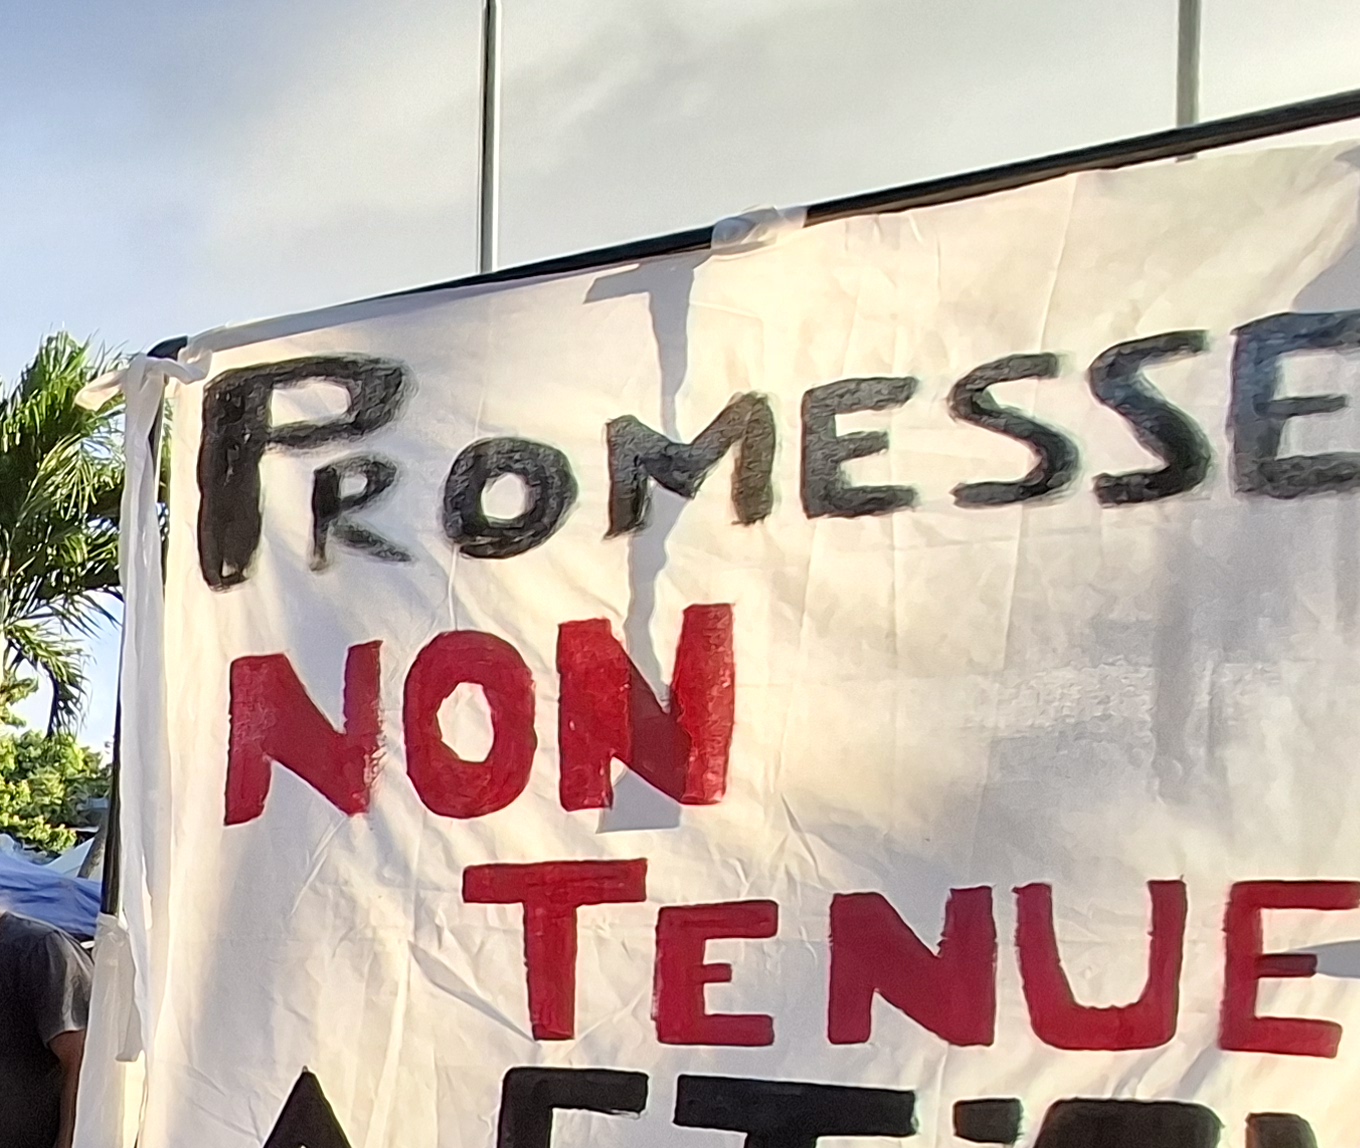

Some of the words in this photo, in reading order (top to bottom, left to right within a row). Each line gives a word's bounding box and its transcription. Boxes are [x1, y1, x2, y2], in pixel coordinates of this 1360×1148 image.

[195, 310, 1360, 592] PROMESSE
[224, 602, 735, 827] NON
[462, 857, 1360, 1059] TENUE
